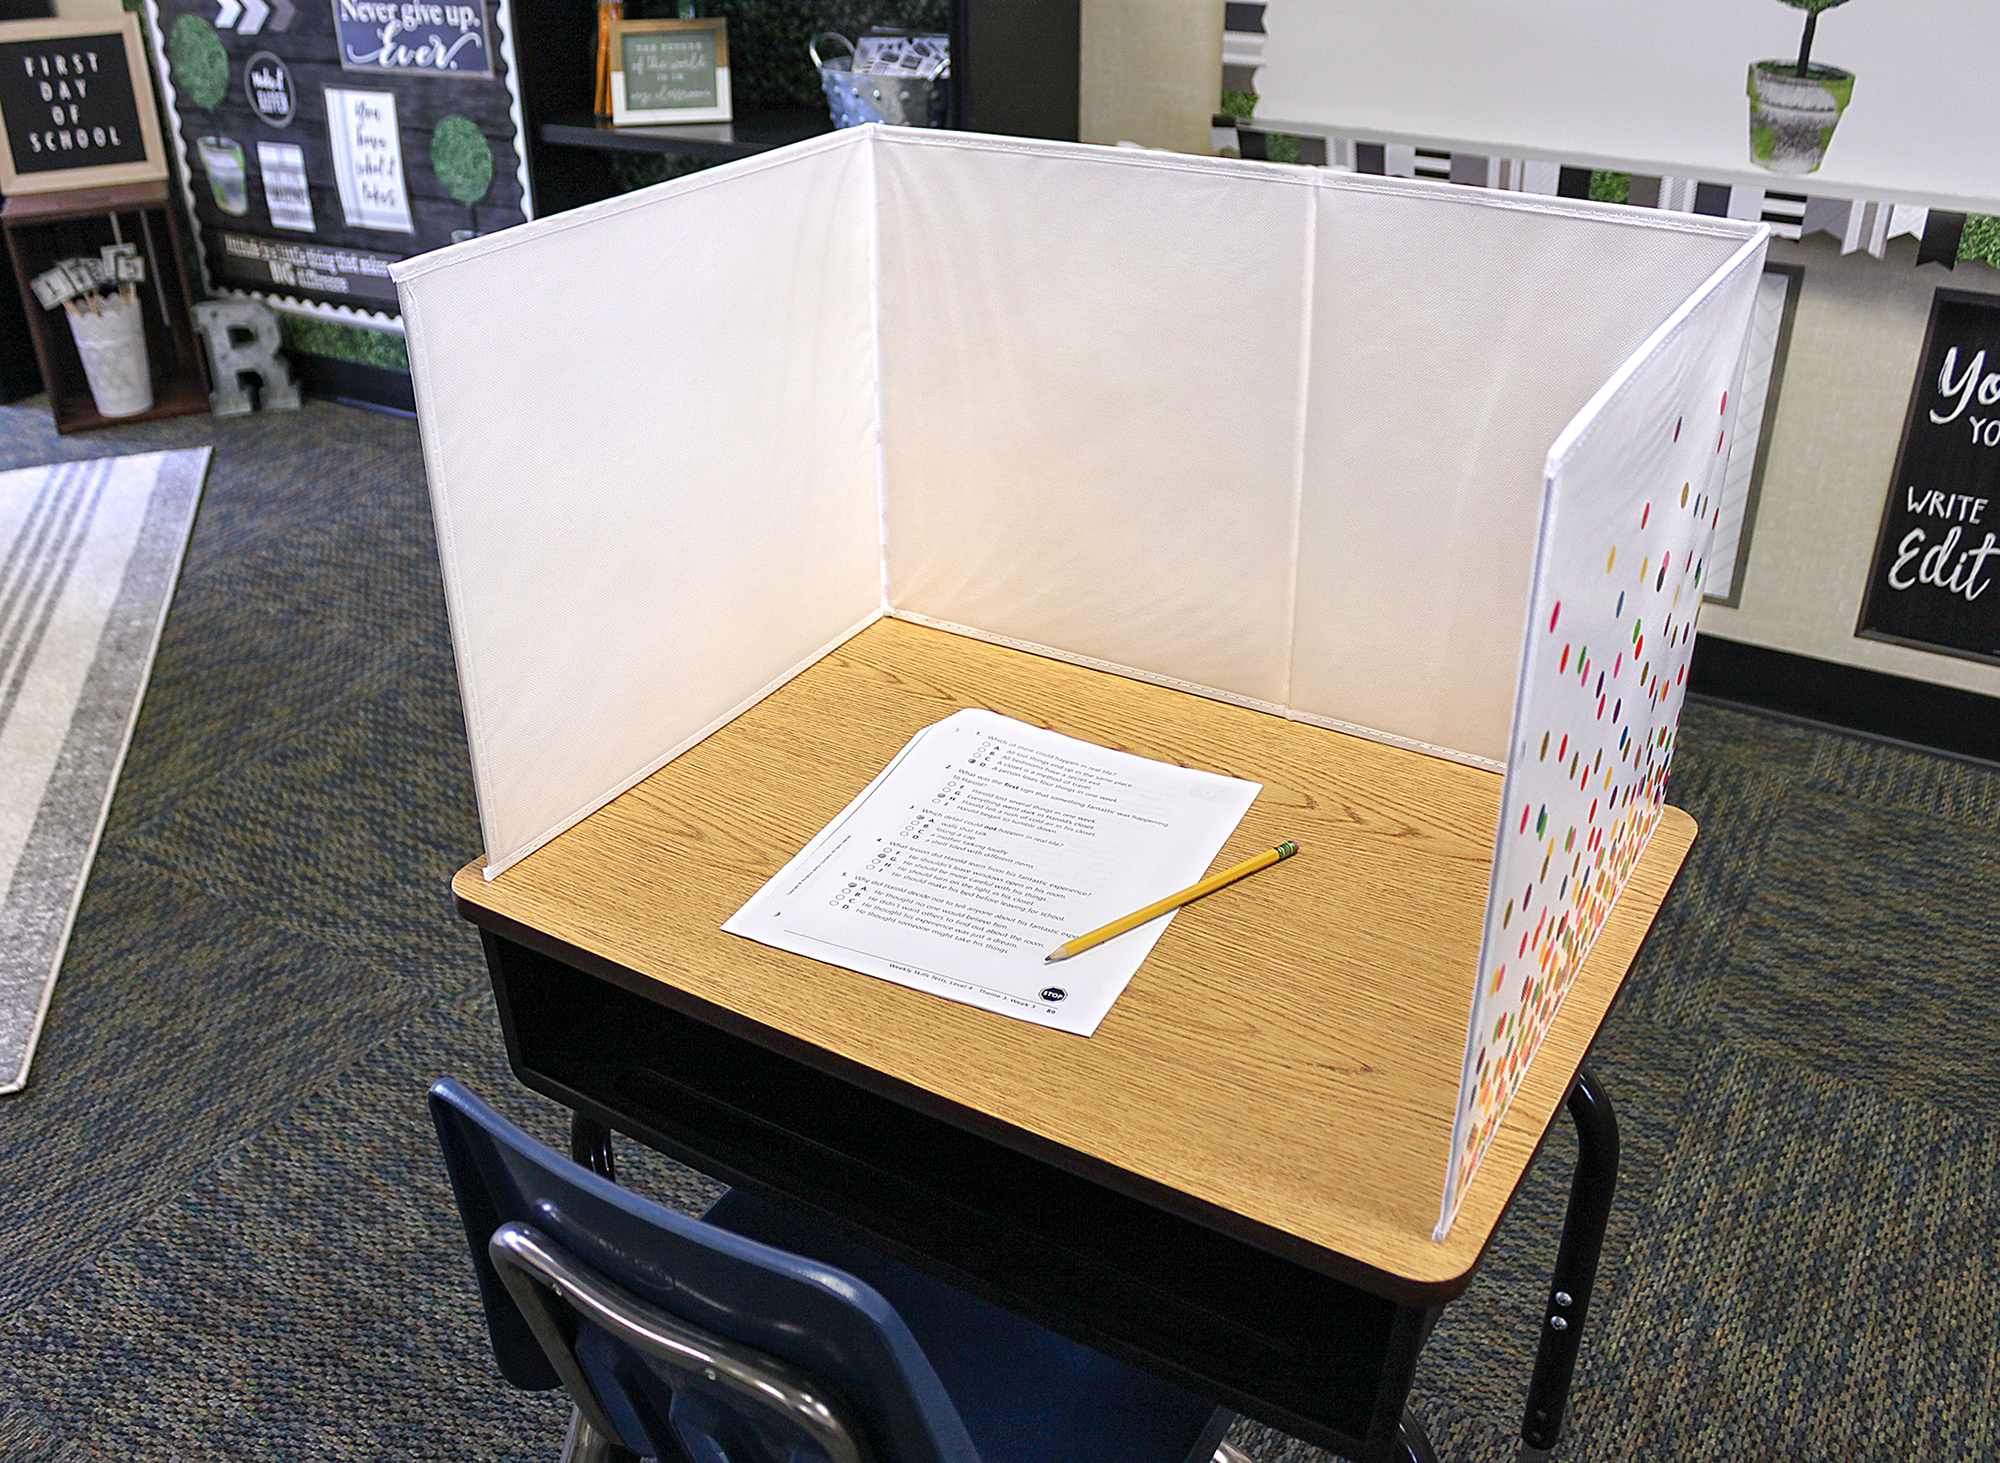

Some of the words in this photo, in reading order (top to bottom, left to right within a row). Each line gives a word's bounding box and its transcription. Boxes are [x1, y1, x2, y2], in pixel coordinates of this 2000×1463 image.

[444, 5, 481, 33] up.
[347, 19, 482, 70] Ever.
[24, 52, 98, 77] FIRST
[40, 79, 87, 102] DAY
[52, 104, 79, 126] OF
[29, 126, 121, 153] SCHOOL
[191, 299, 302, 417] R
[1907, 485, 1989, 525] WRITE
[1887, 525, 2000, 602] Edit
[889, 841, 908, 849] What
[908, 846, 930, 855] lesson
[943, 855, 968, 864] Harold
[968, 861, 986, 869] learn
[987, 865, 1004, 874] from
[1017, 873, 1048, 886] fantastic
[1048, 883, 1092, 897] experience?
[914, 863, 938, 872] should
[948, 872, 968, 880] more
[968, 877, 994, 887] careful
[994, 884, 1011, 892] with
[920, 857, 952, 869] shouldn't
[952, 865, 971, 873] leave
[972, 871, 1004, 882] windows
[1005, 879, 1024, 888] open
[854, 875, 870, 884] Why
[883, 883, 907, 893] Harold
[907, 890, 930, 899] decide
[966, 906, 993, 916] anyone
[994, 914, 1016, 923] about
[1029, 922, 1059, 934] fantastic
[885, 892, 914, 904] thought
[942, 908, 966, 918] would
[965, 914, 992, 925] believe
[903, 875, 927, 884] should
[927, 881, 947, 889] make
[959, 889, 975, 897] bed
[975, 893, 999, 904] before
[1000, 900, 1026, 912] leaving
[867, 911, 896, 923] thought
[897, 920, 930, 932] someone
[931, 929, 953, 939] might
[954, 935, 971, 943] take
[873, 905, 902, 916] thought
[914, 917, 953, 930] experience
[879, 899, 900, 908] didn't
[901, 905, 920, 914] want
[920, 911, 944, 920] others
[954, 919, 971, 927] find
[985, 928, 1008, 938] about
[1043, 990, 1063, 1000] STOP
